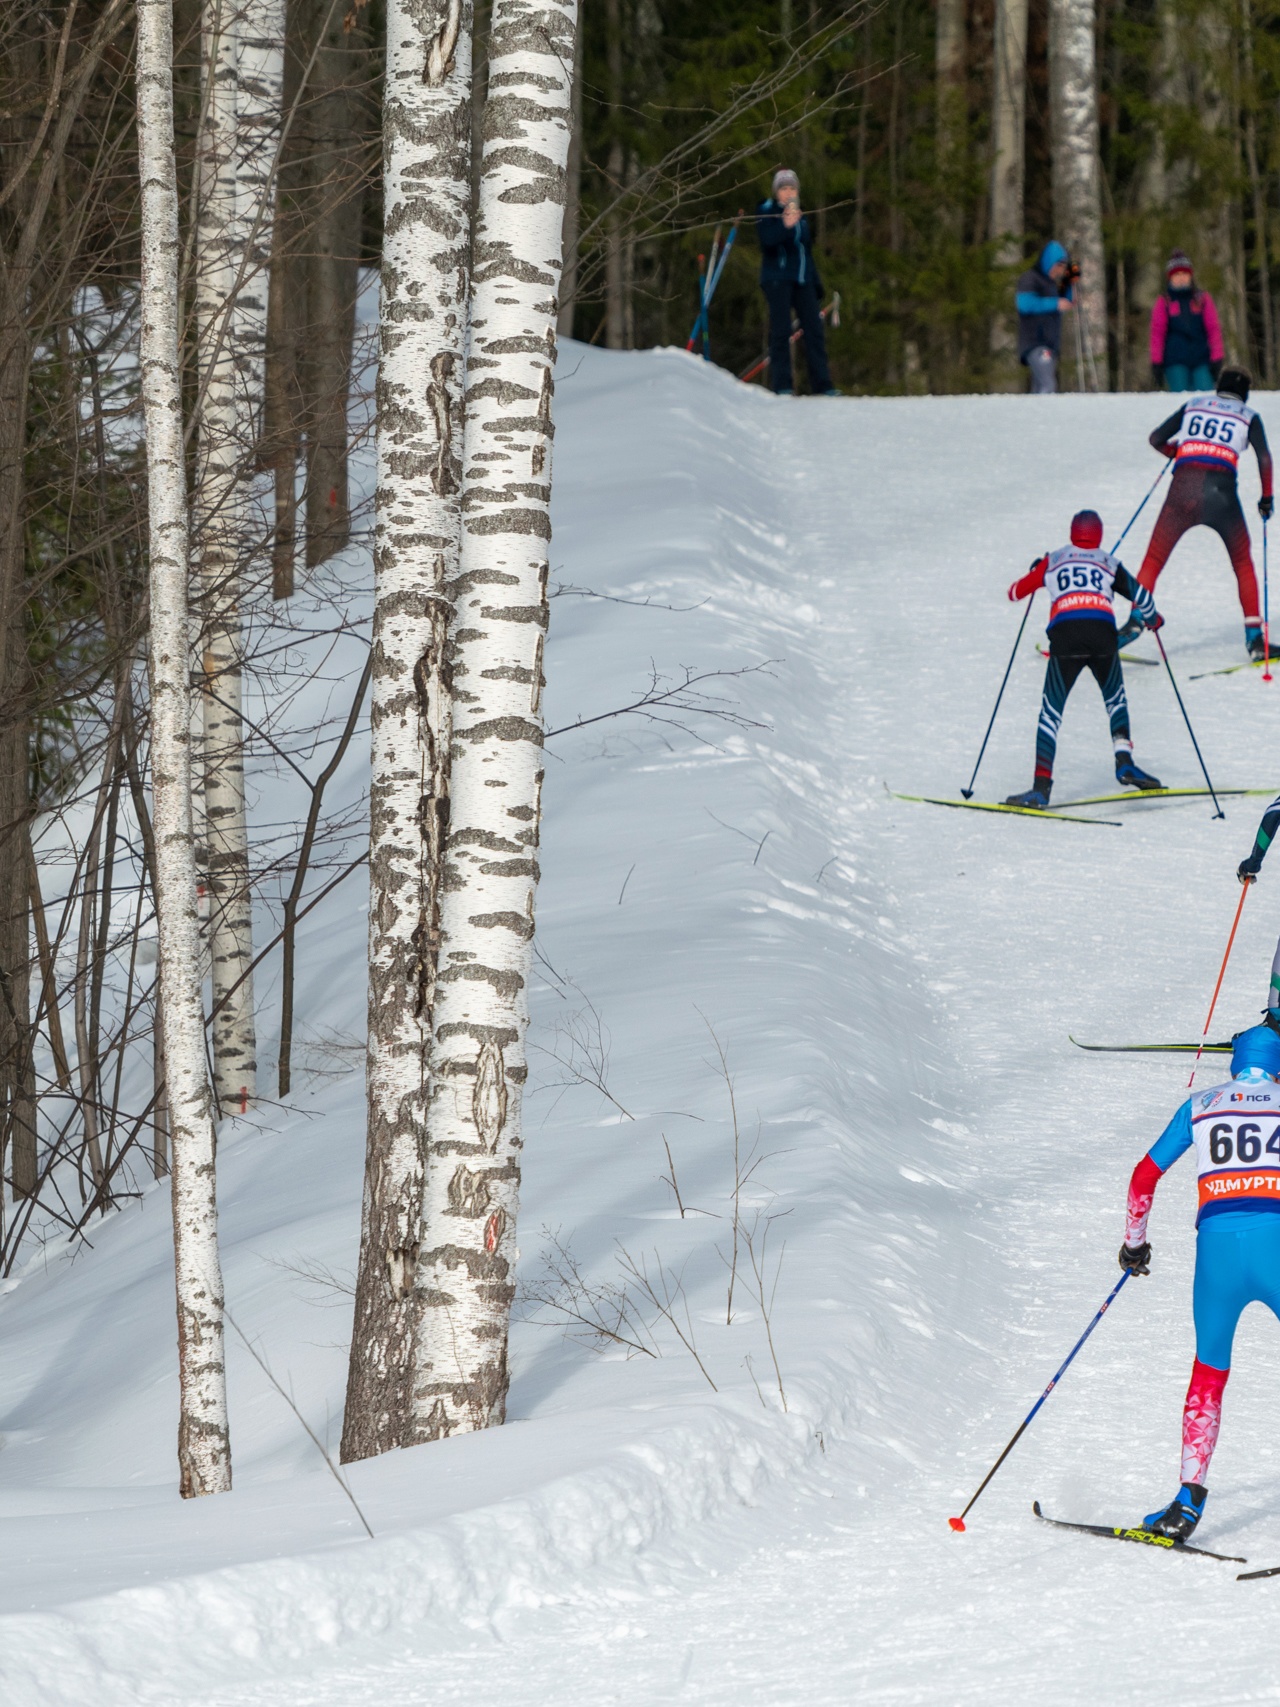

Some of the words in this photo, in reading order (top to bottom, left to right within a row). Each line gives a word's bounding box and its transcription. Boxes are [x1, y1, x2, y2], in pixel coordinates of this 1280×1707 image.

[1188, 415, 1236, 443] 665
[1056, 566, 1103, 592] 658
[1246, 1094, 1271, 1102] ПСБ
[1123, 1528, 1175, 1548] FISCHER
